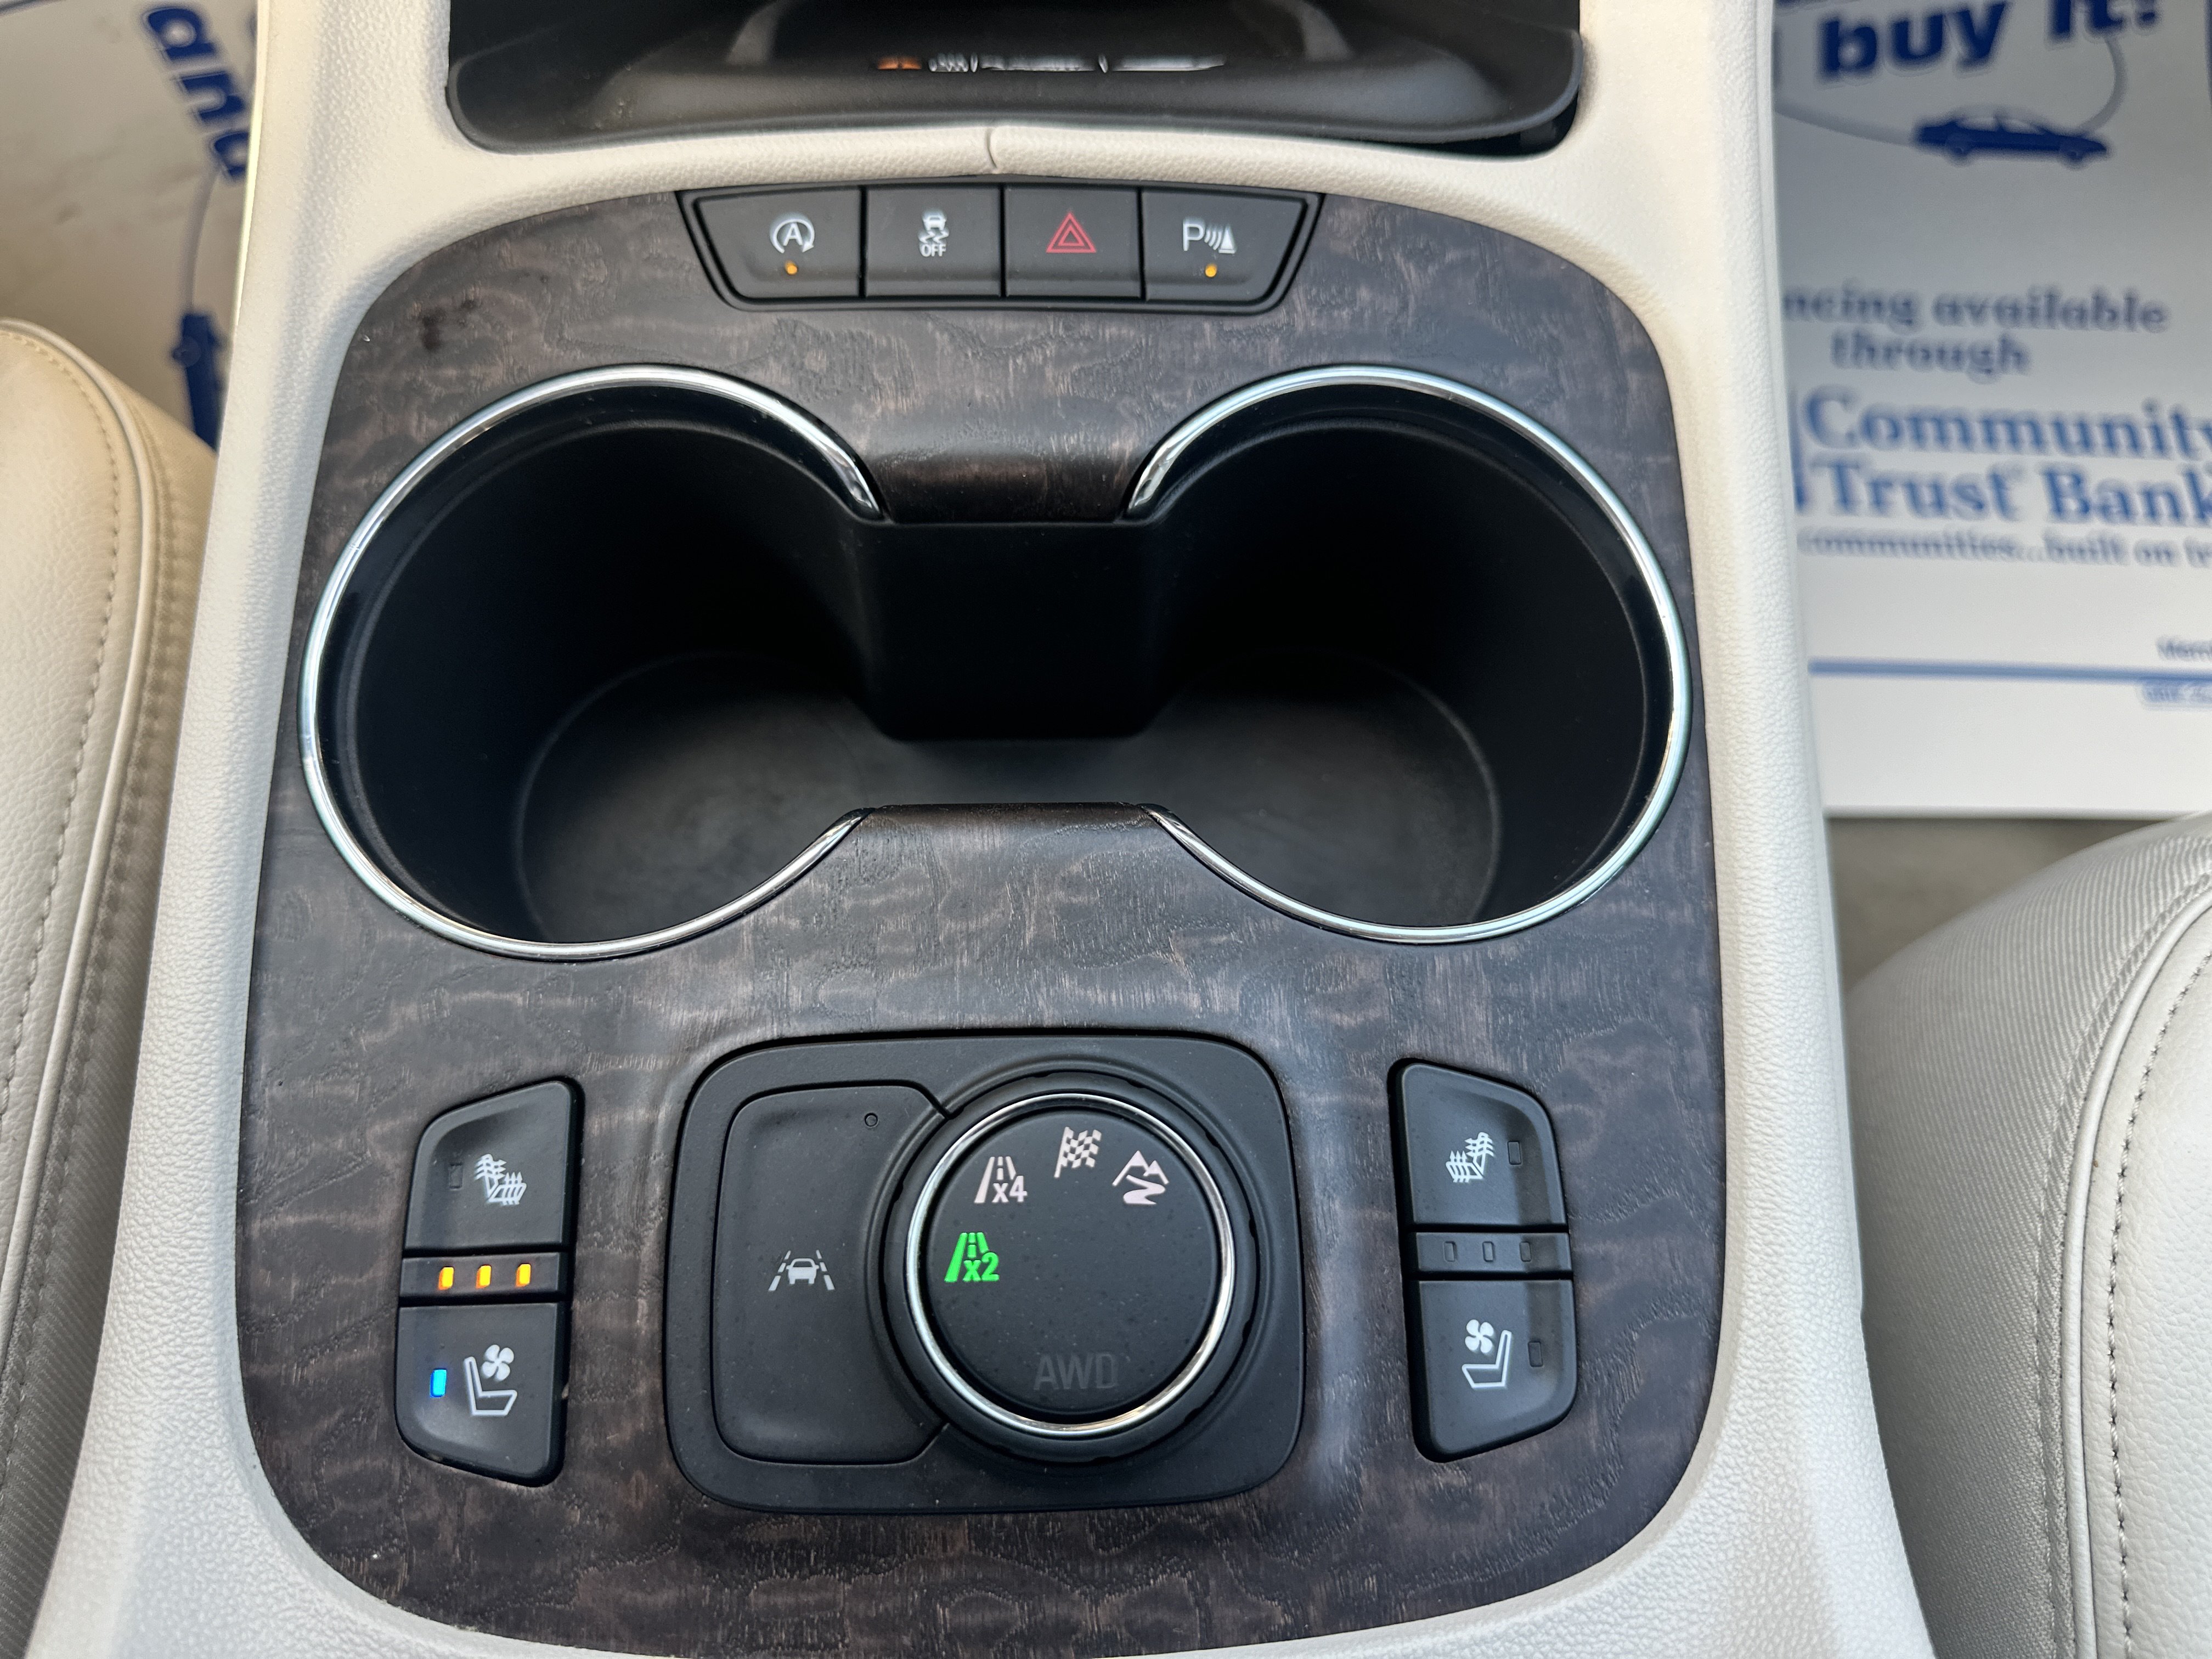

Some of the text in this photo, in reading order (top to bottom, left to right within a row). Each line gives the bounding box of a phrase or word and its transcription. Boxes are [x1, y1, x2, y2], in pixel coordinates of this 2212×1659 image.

[1818, 1, 2008, 80] buy
[919, 243, 947, 257] OFF
[1931, 286, 2170, 332] available
[1831, 331, 2031, 382] through
[1809, 455, 2021, 521] Trust
[992, 1175, 1028, 1203] x4
[963, 1251, 1000, 1282] x2
[1034, 1352, 1119, 1391] AWD
